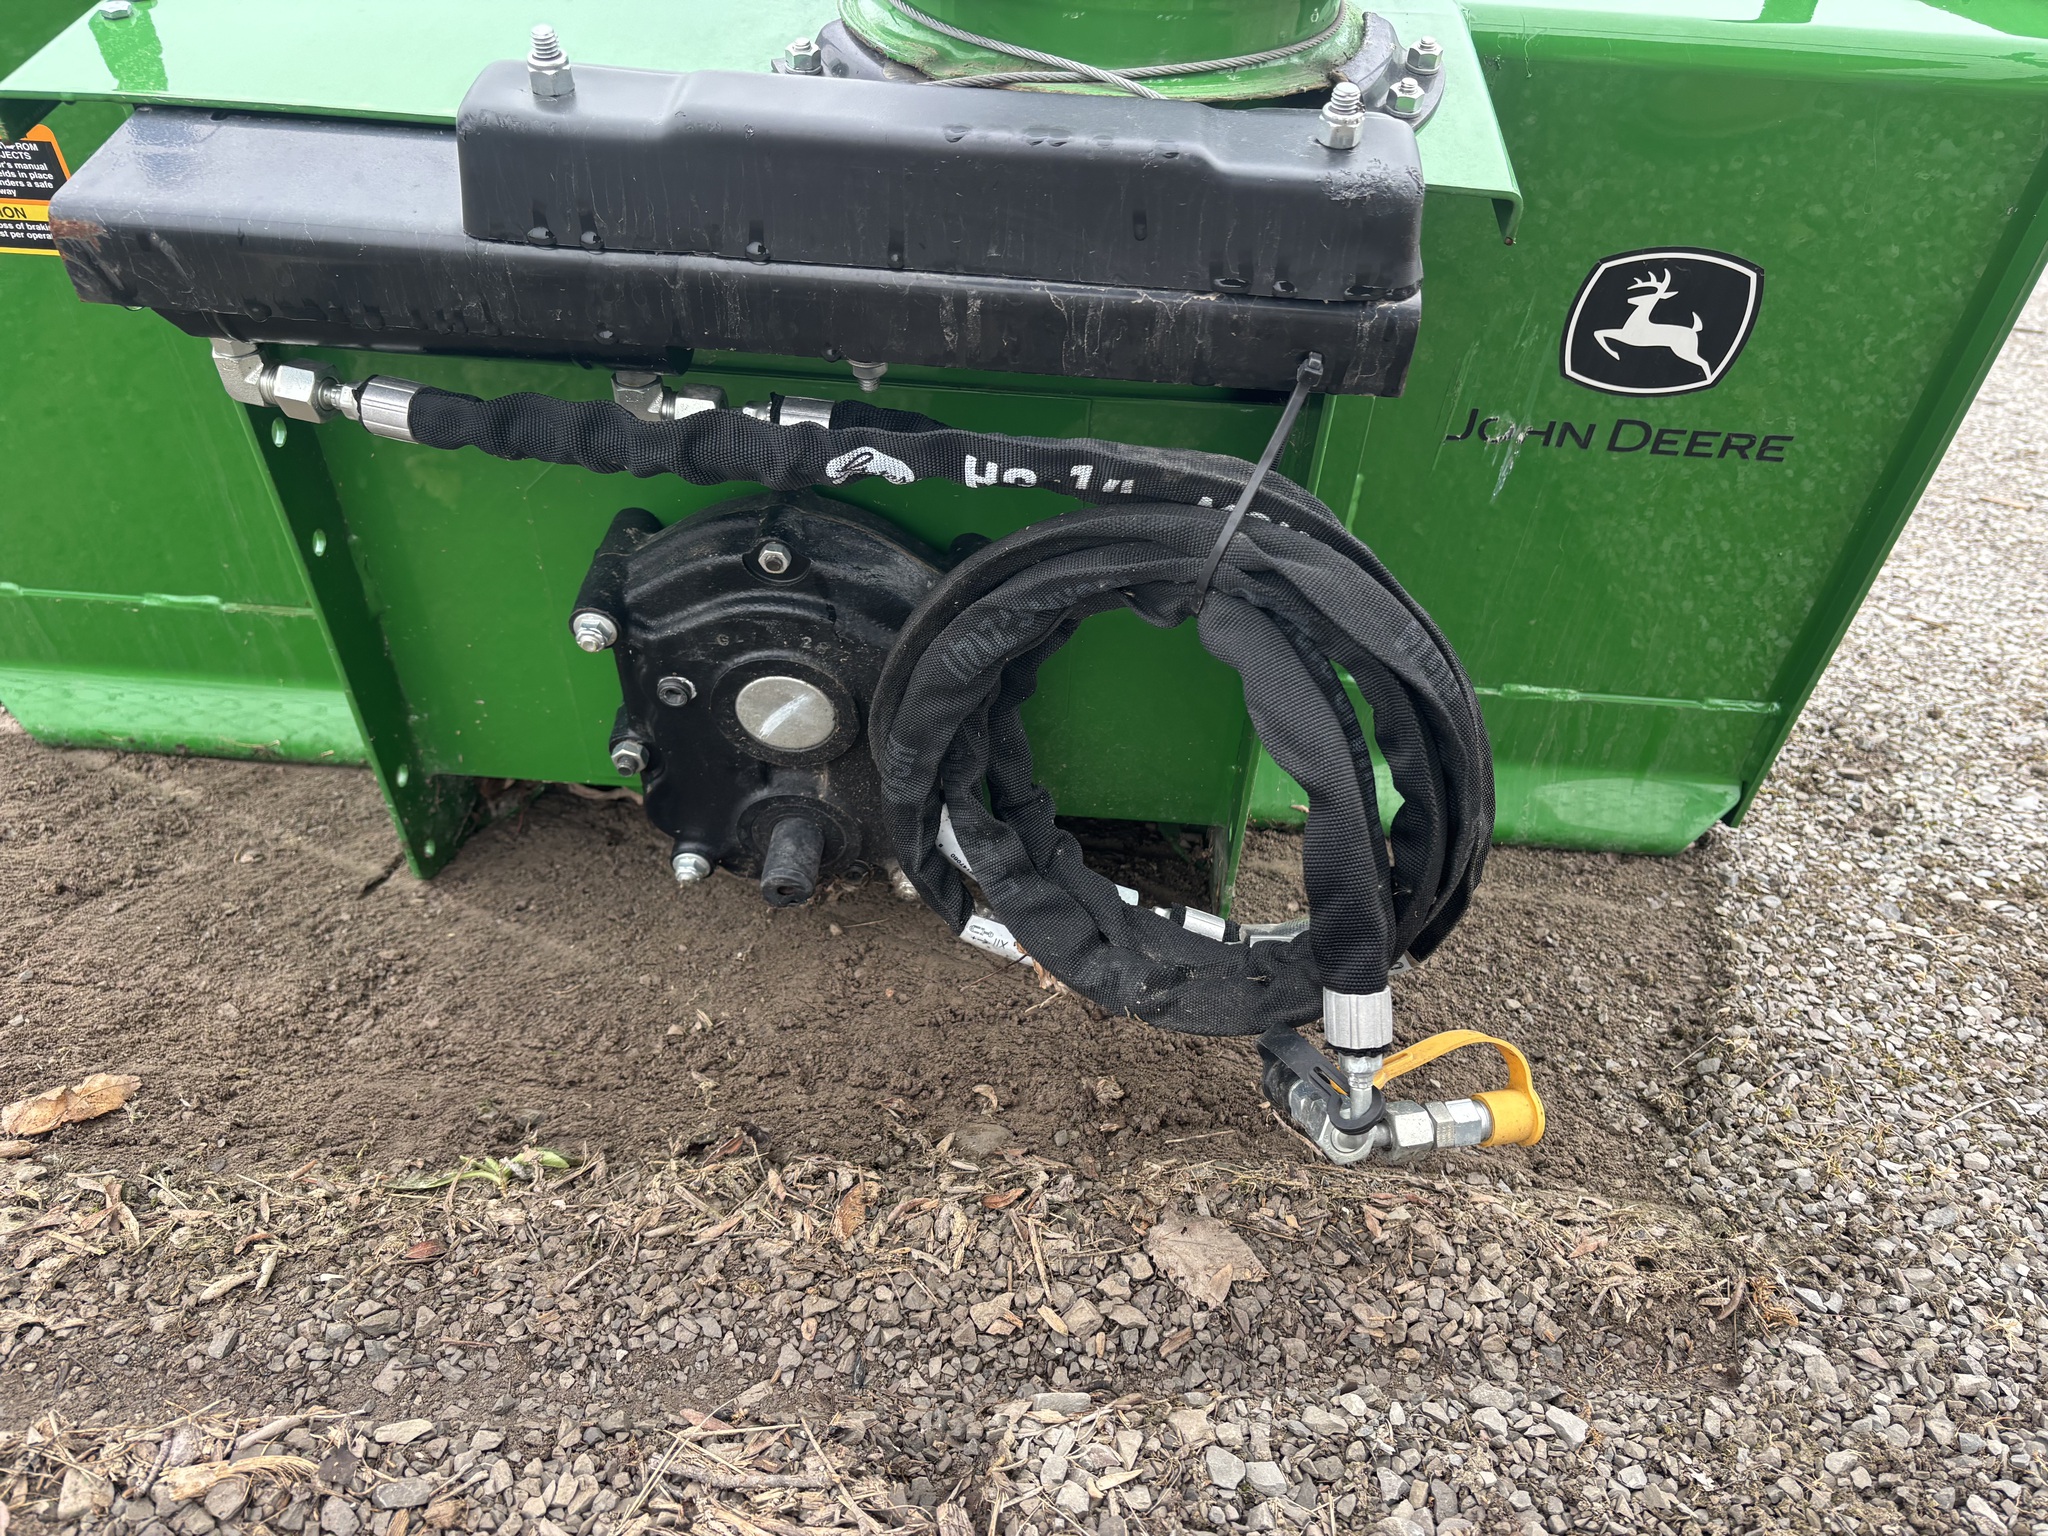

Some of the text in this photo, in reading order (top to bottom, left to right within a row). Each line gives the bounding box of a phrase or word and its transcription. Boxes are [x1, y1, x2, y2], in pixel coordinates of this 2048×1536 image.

[14, 142, 38, 151] ROM
[14, 163, 48, 171] manual
[17, 170, 28, 179] in
[29, 171, 54, 180] place
[34, 181, 54, 189] safe
[15, 221, 25, 230] of
[9, 231, 25, 240] per
[1446, 407, 1795, 463] JOHN DEERE
